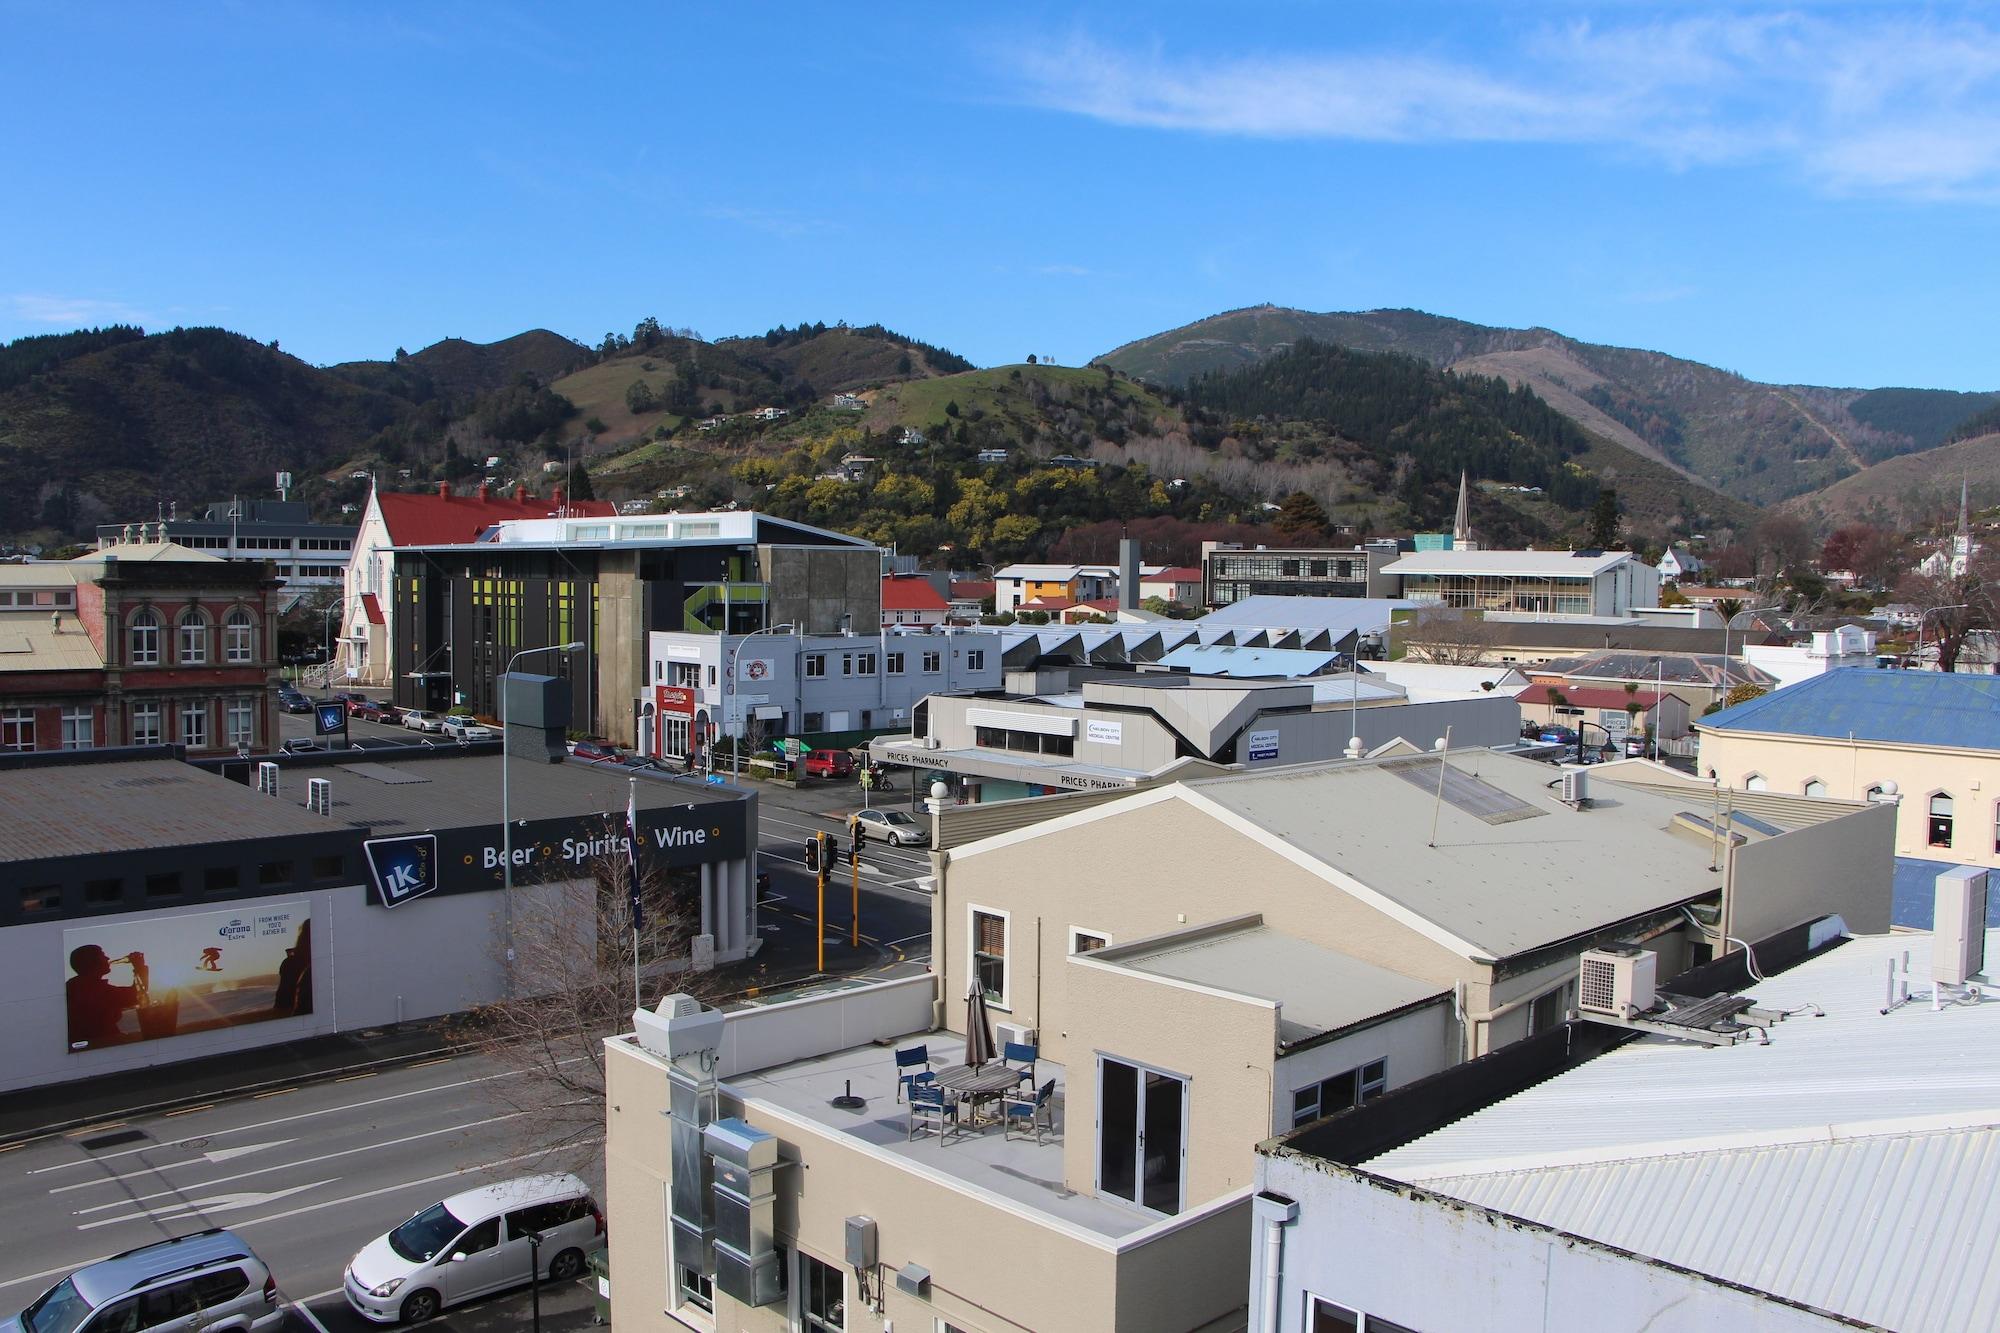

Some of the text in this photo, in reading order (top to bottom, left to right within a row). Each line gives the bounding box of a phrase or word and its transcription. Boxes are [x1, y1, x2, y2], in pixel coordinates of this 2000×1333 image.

[887, 752, 949, 768] PRICES PHARMACY
[1061, 775, 1125, 790] PRICES PHARM
[483, 827, 706, 869] Beer Spirits Wine
[219, 925, 251, 936] Corona
